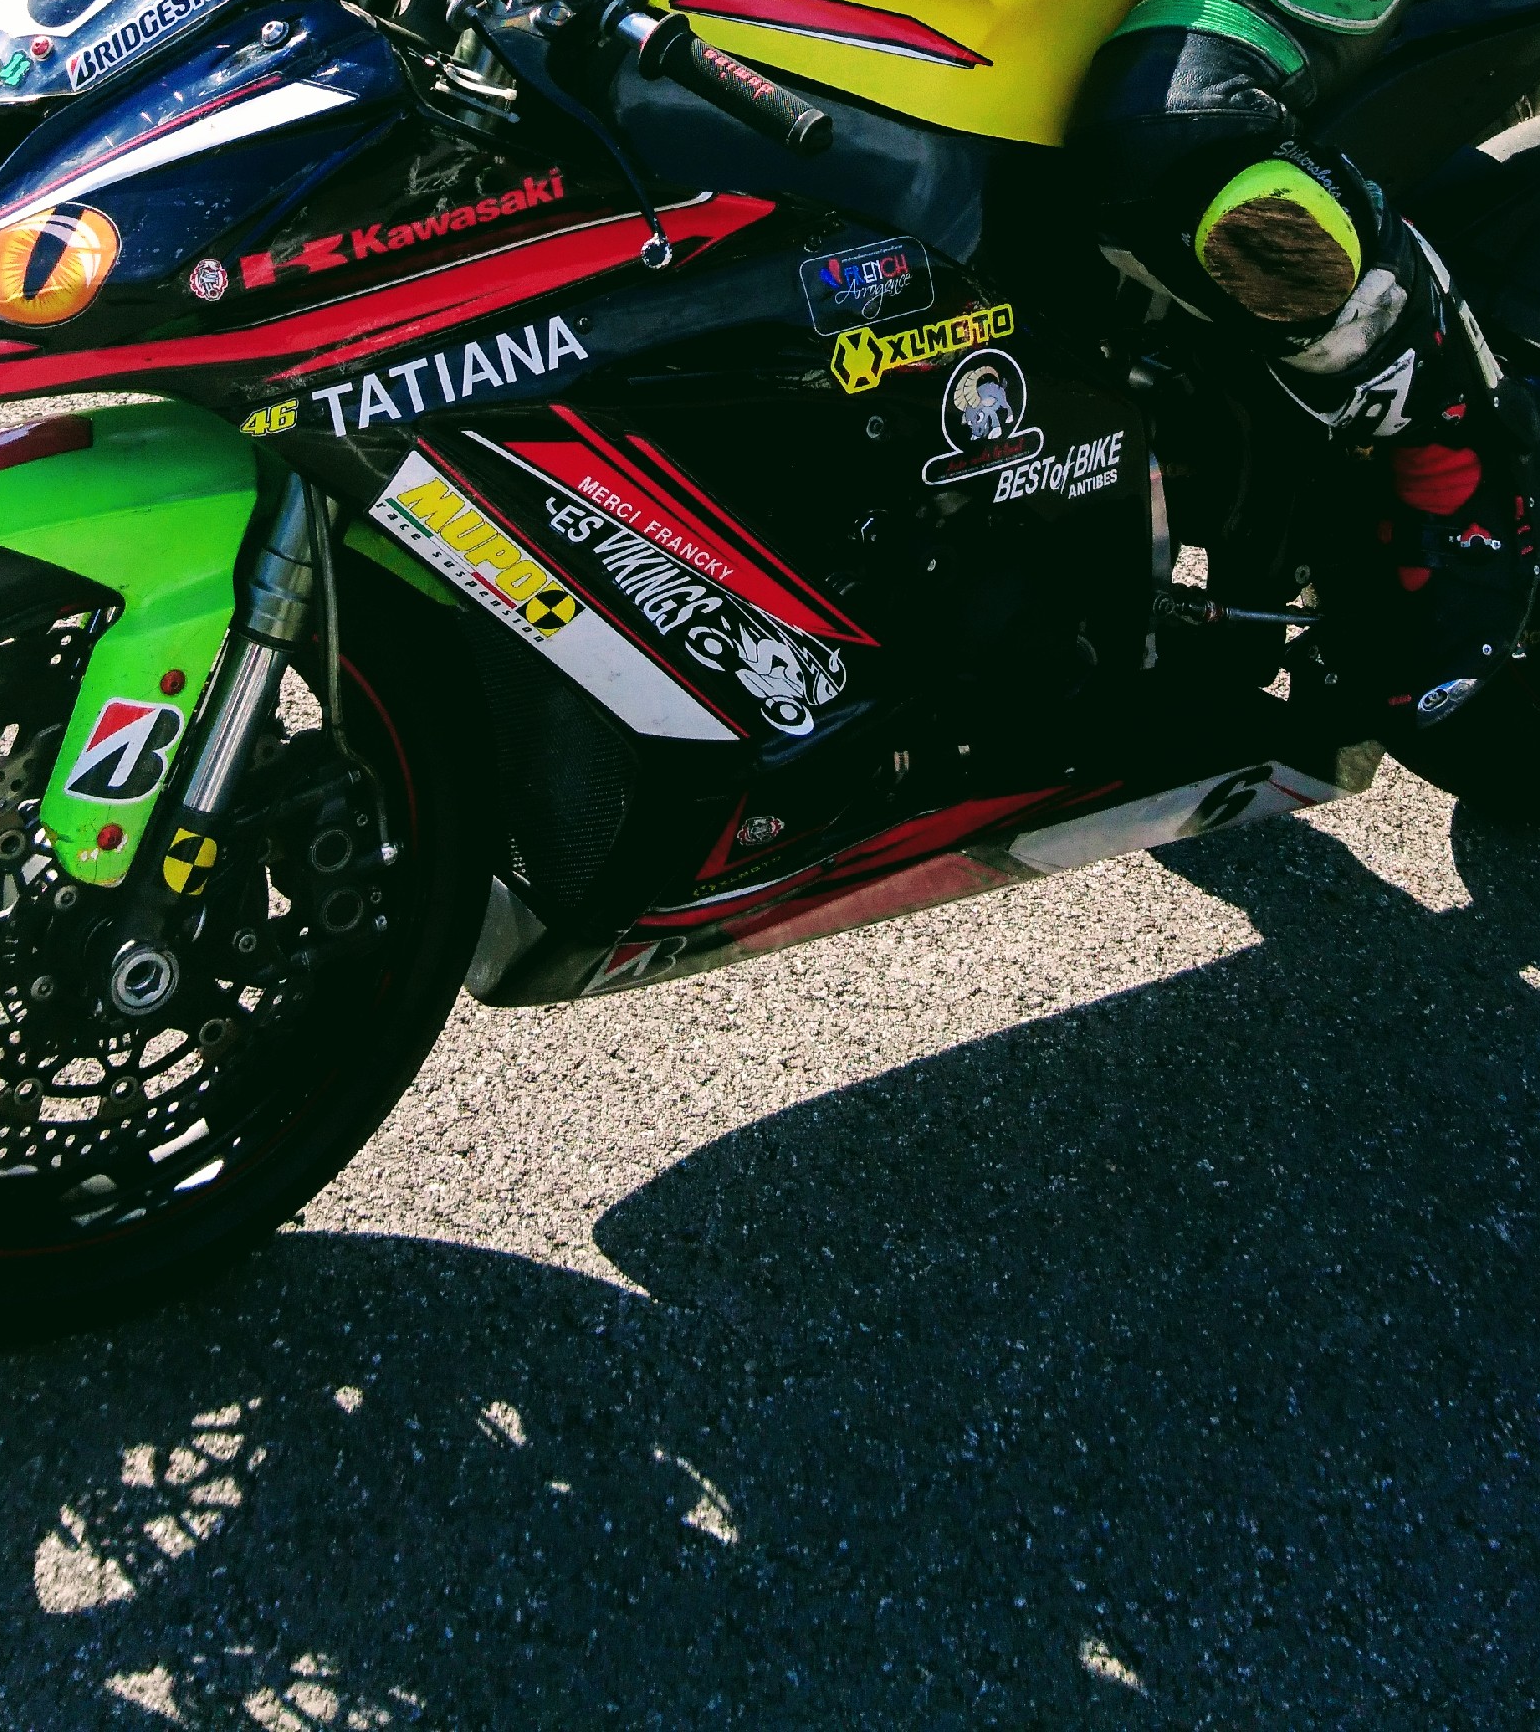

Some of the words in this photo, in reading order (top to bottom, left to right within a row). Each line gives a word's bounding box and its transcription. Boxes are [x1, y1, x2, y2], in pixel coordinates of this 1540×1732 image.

[349, 166, 564, 260] Kawasaki
[843, 253, 909, 288] FRENCH
[888, 306, 1012, 364] XLMOTO
[311, 315, 589, 438] TATIANA
[240, 398, 299, 437] 46
[577, 475, 641, 524] MERCI
[1068, 468, 1118, 500] ANTIBES
[376, 501, 422, 541] race
[432, 551, 545, 643] suspension
[397, 476, 548, 602] MUPO
[643, 520, 734, 581] FRANCKY
[592, 528, 723, 636] VIKINGS
[1175, 765, 1274, 837] 6
